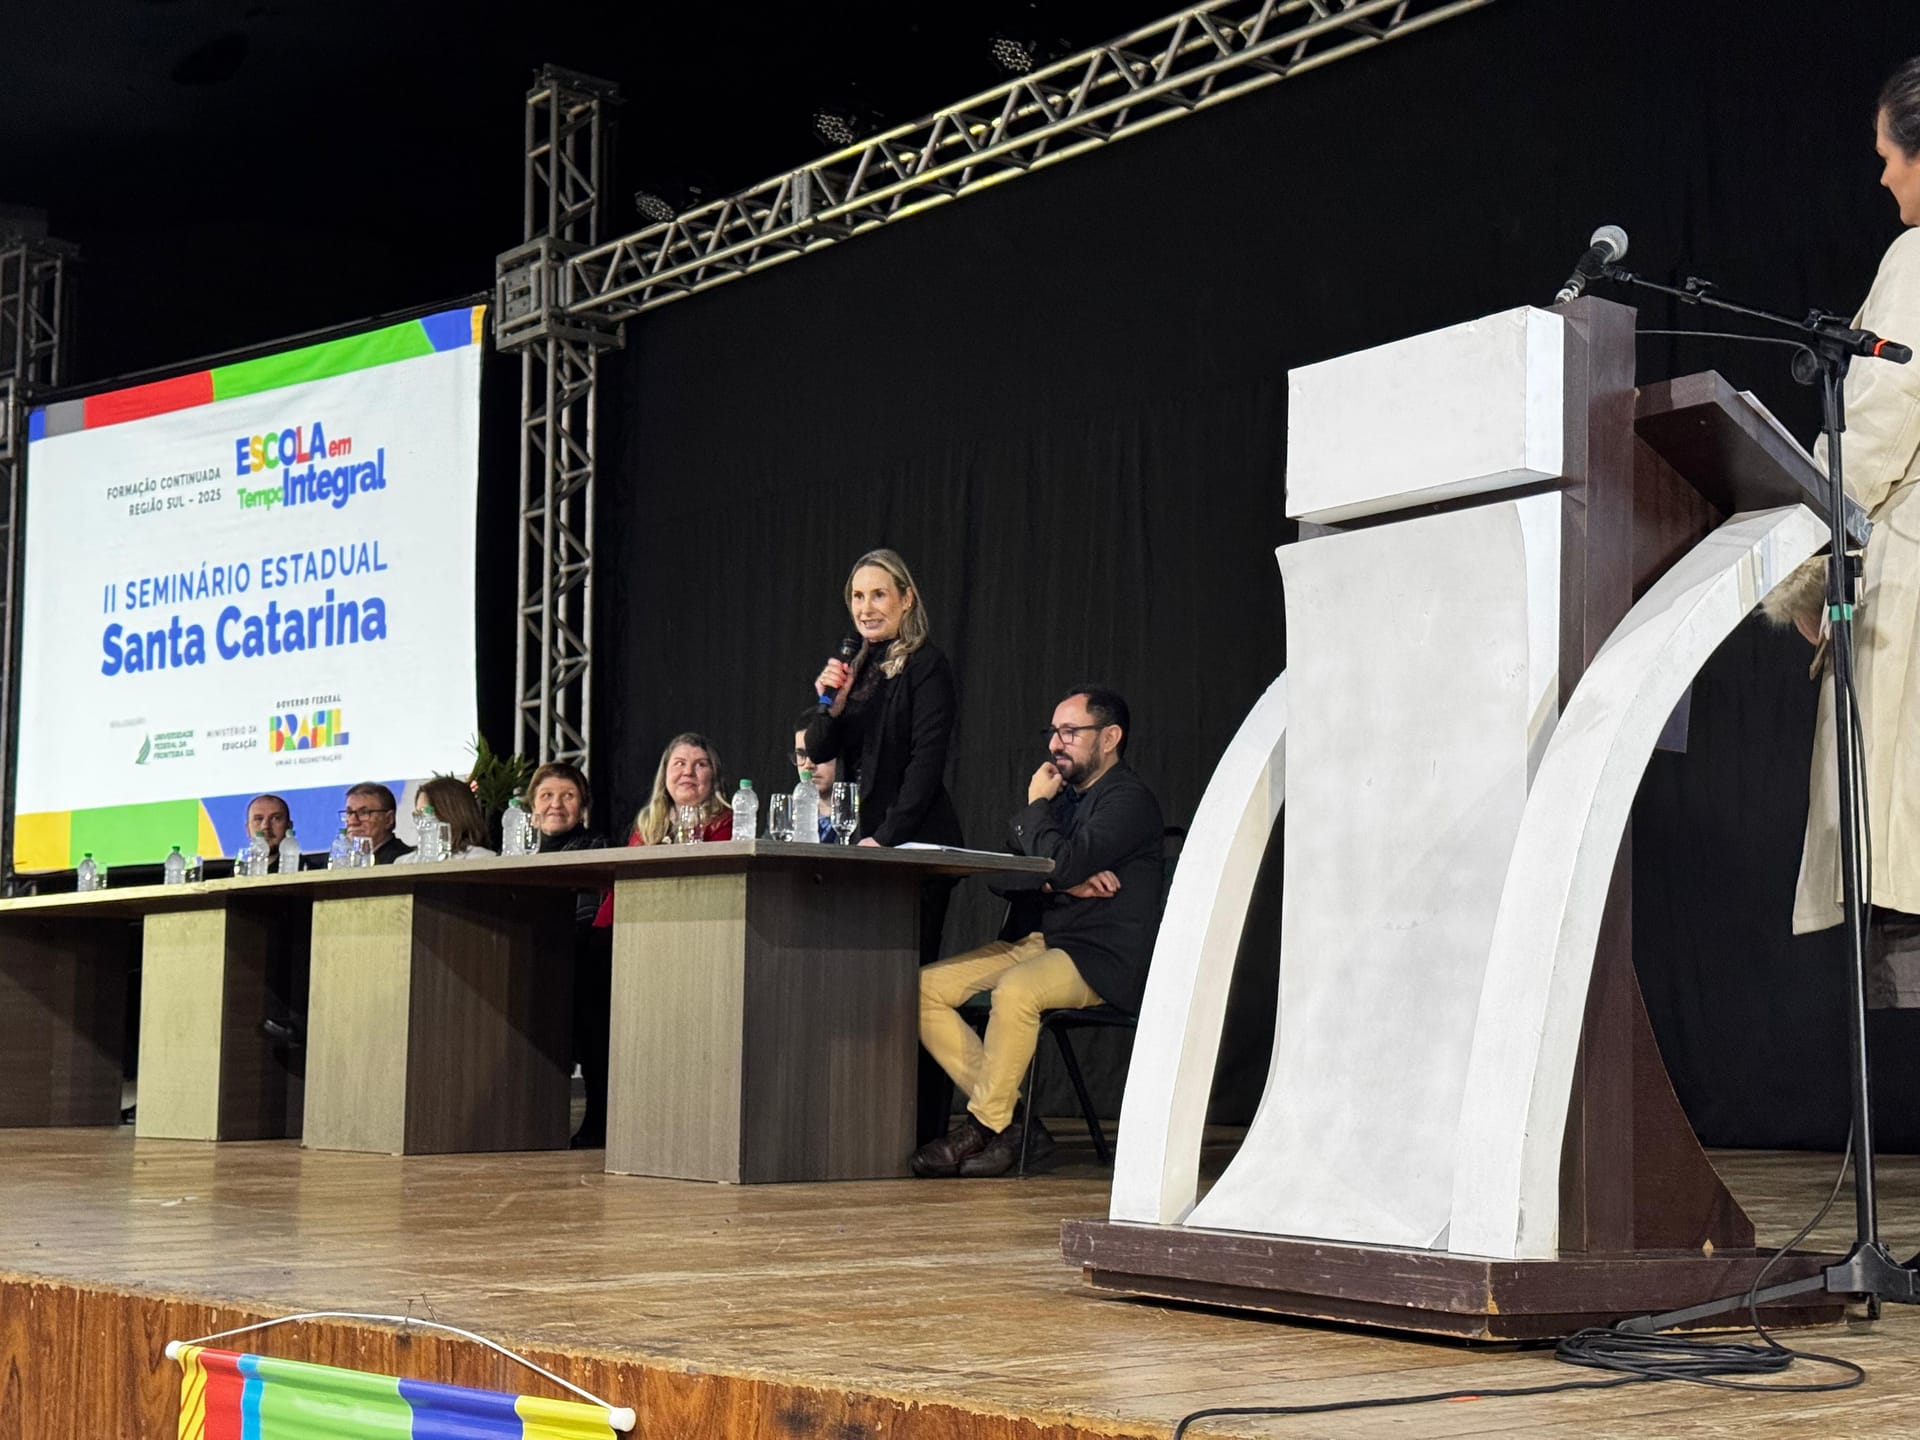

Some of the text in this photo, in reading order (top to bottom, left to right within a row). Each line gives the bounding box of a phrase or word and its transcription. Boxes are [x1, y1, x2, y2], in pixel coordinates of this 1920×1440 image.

[236, 421, 352, 476] ESCOLA em
[107, 467, 221, 500] FORMAÇÃO CONTINUADA
[129, 497, 163, 516] REGIÃO
[167, 496, 184, 510] SUL
[198, 488, 221, 504] 2025
[283, 447, 387, 509] Integral
[104, 541, 388, 614] II SEMINÁRIO ESTADUAL
[101, 588, 387, 676] Santa Catarina
[269, 708, 349, 753] BRASIL
